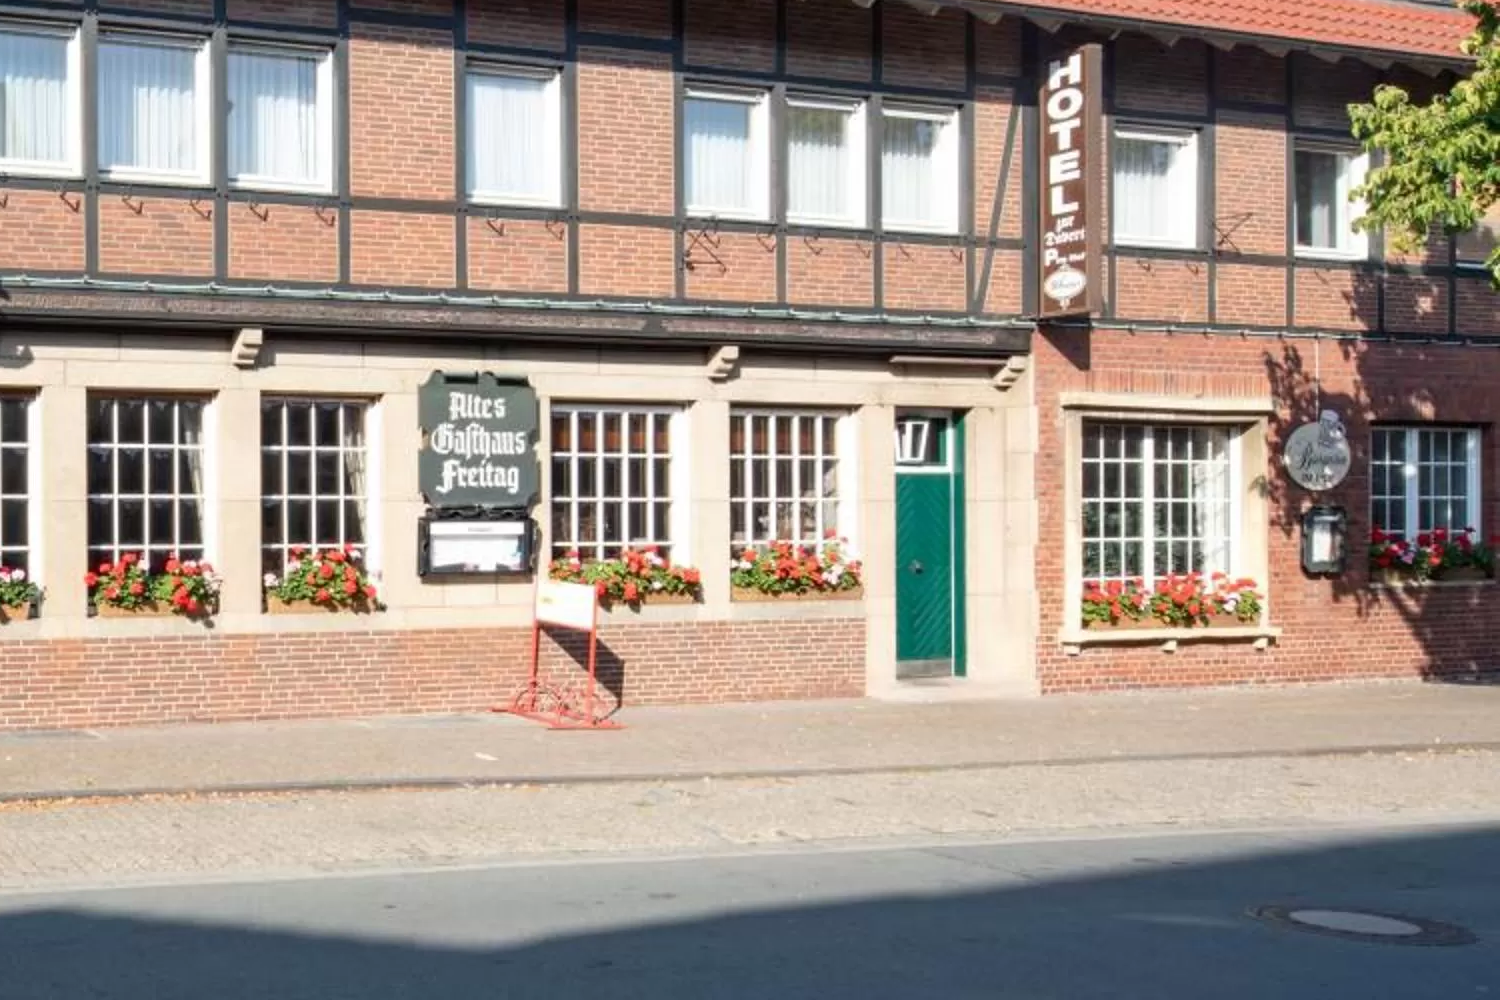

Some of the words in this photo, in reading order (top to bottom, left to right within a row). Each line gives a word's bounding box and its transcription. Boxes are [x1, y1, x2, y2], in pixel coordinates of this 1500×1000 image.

[1047, 53, 1084, 216] HOTEL
[449, 391, 507, 421] Altes
[435, 457, 520, 494] Freitag
